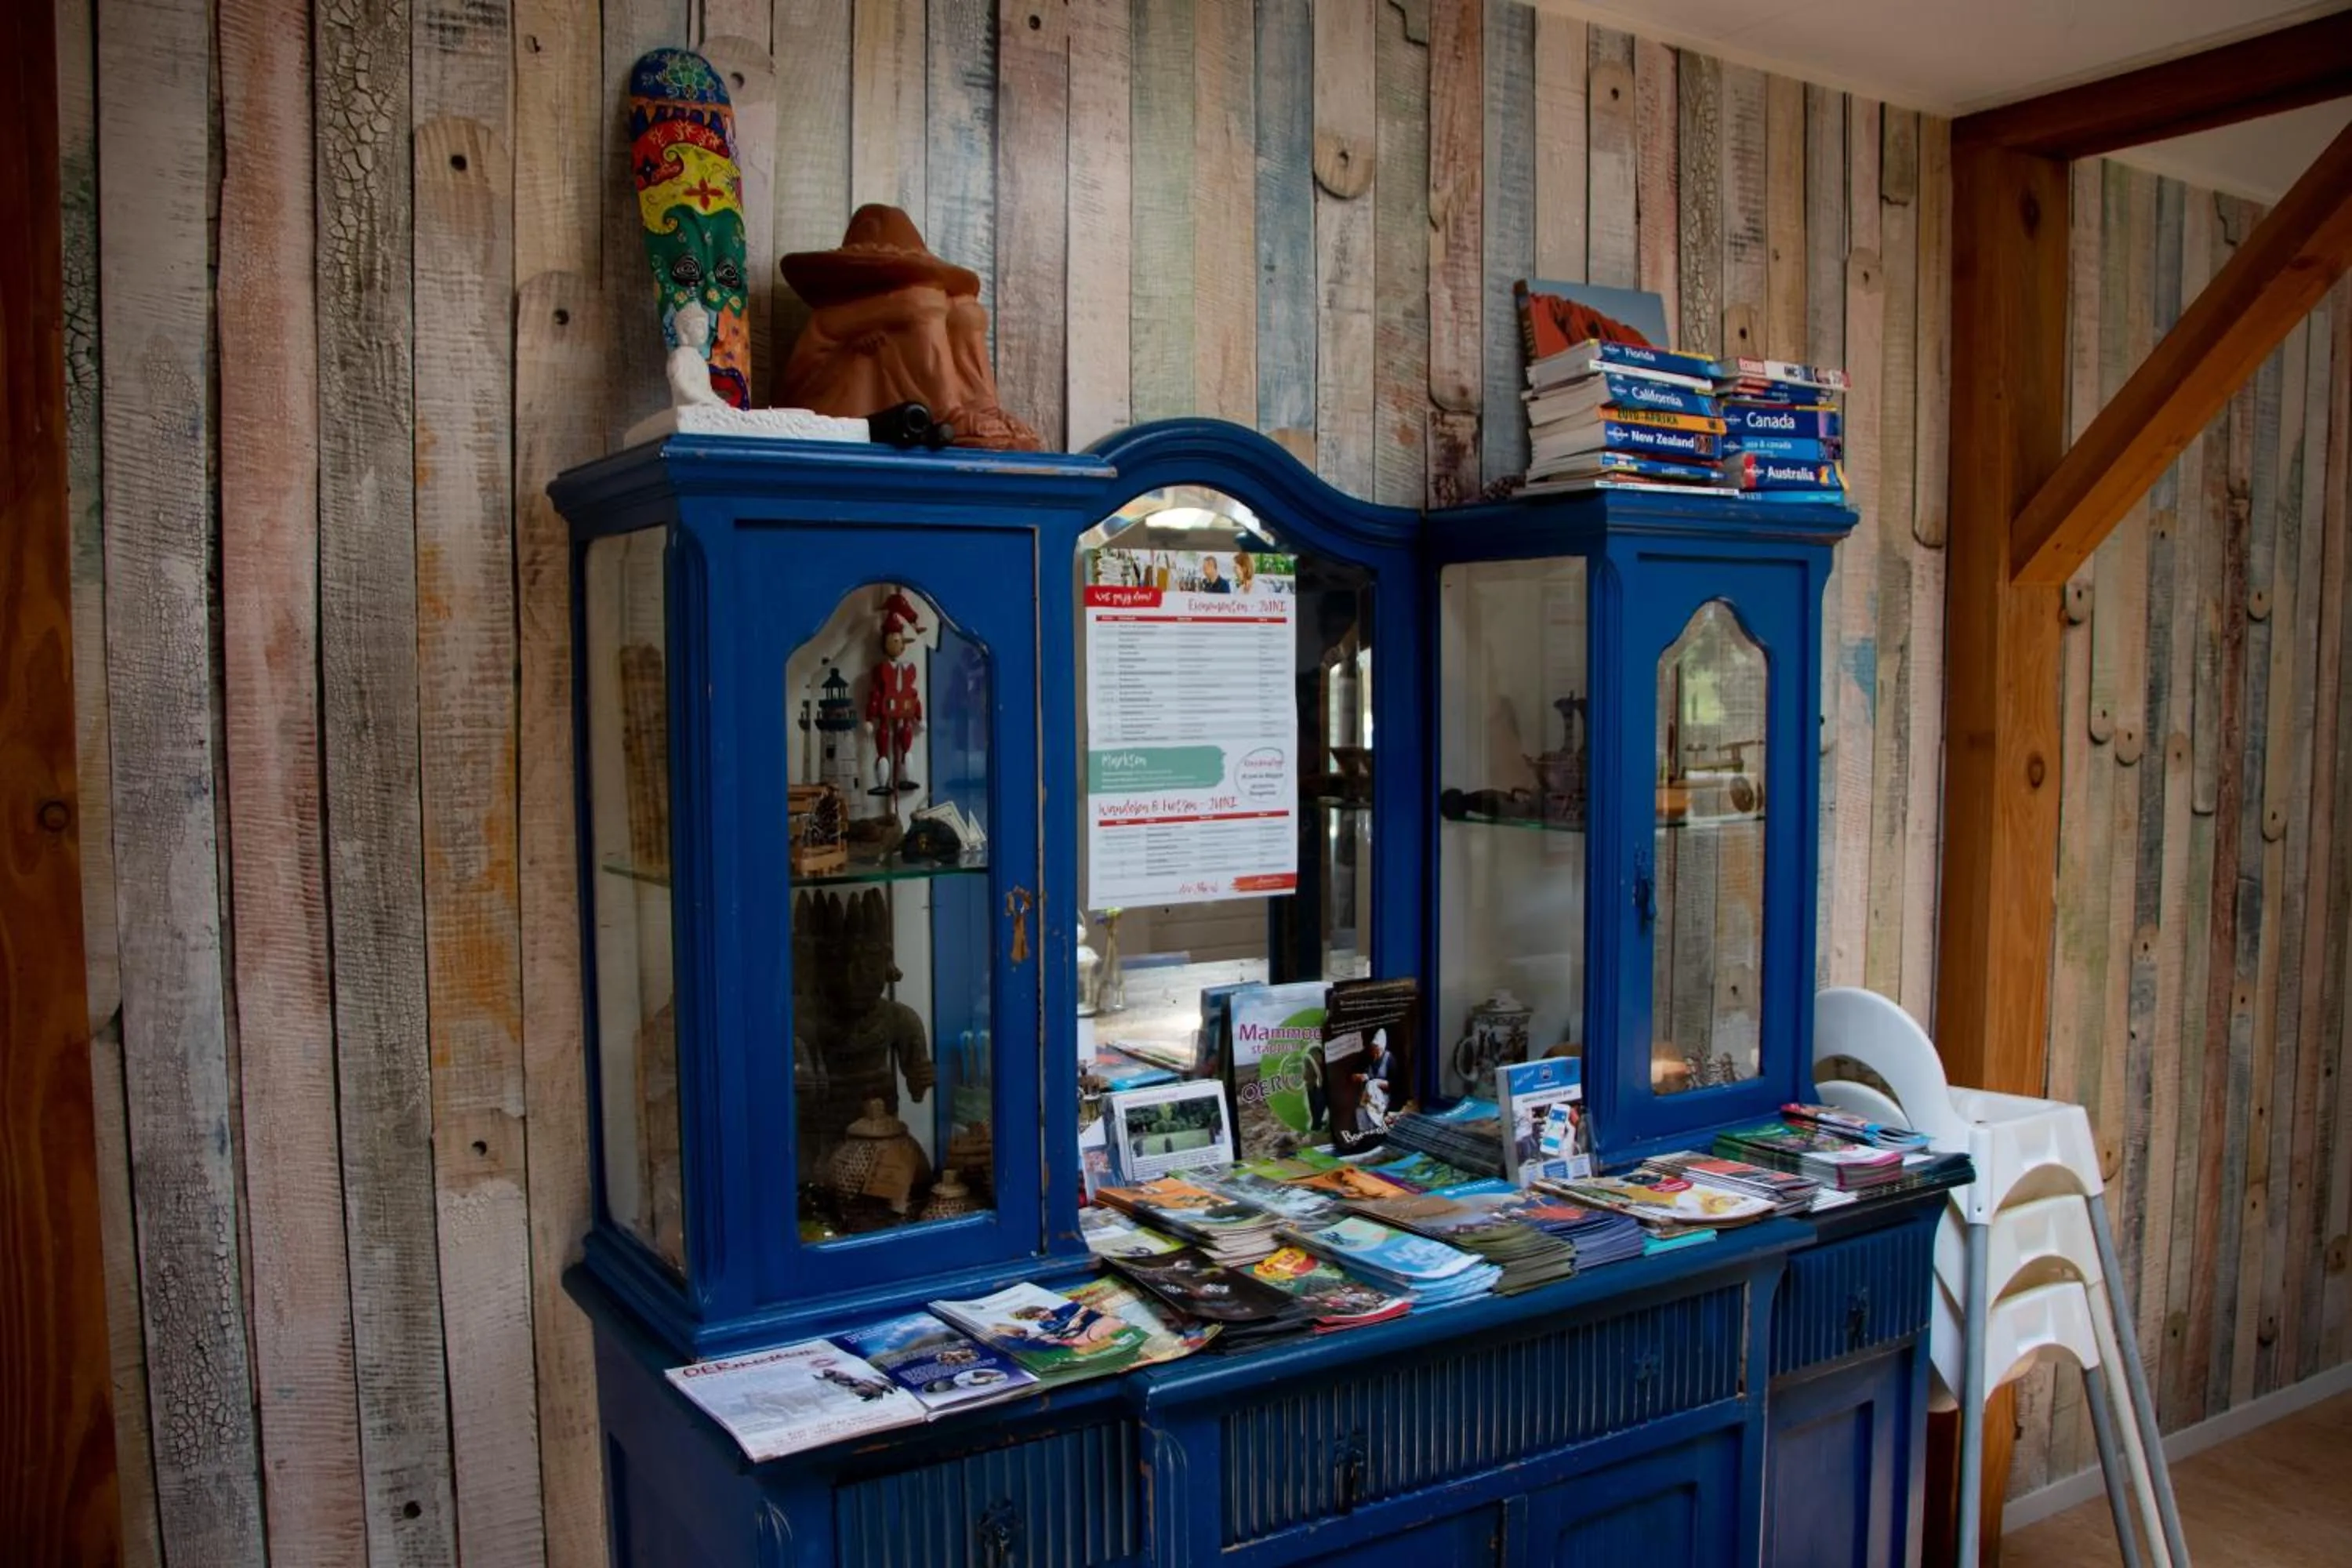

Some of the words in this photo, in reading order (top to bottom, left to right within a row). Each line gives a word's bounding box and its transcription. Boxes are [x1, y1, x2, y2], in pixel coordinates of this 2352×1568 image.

[1624, 347, 1656, 361] Florida
[1632, 387, 1683, 408] California
[1746, 412, 1795, 430] Canada
[1631, 430, 1654, 444] New
[1656, 433, 1694, 448] Zealand
[1768, 466, 1815, 481] Australia
